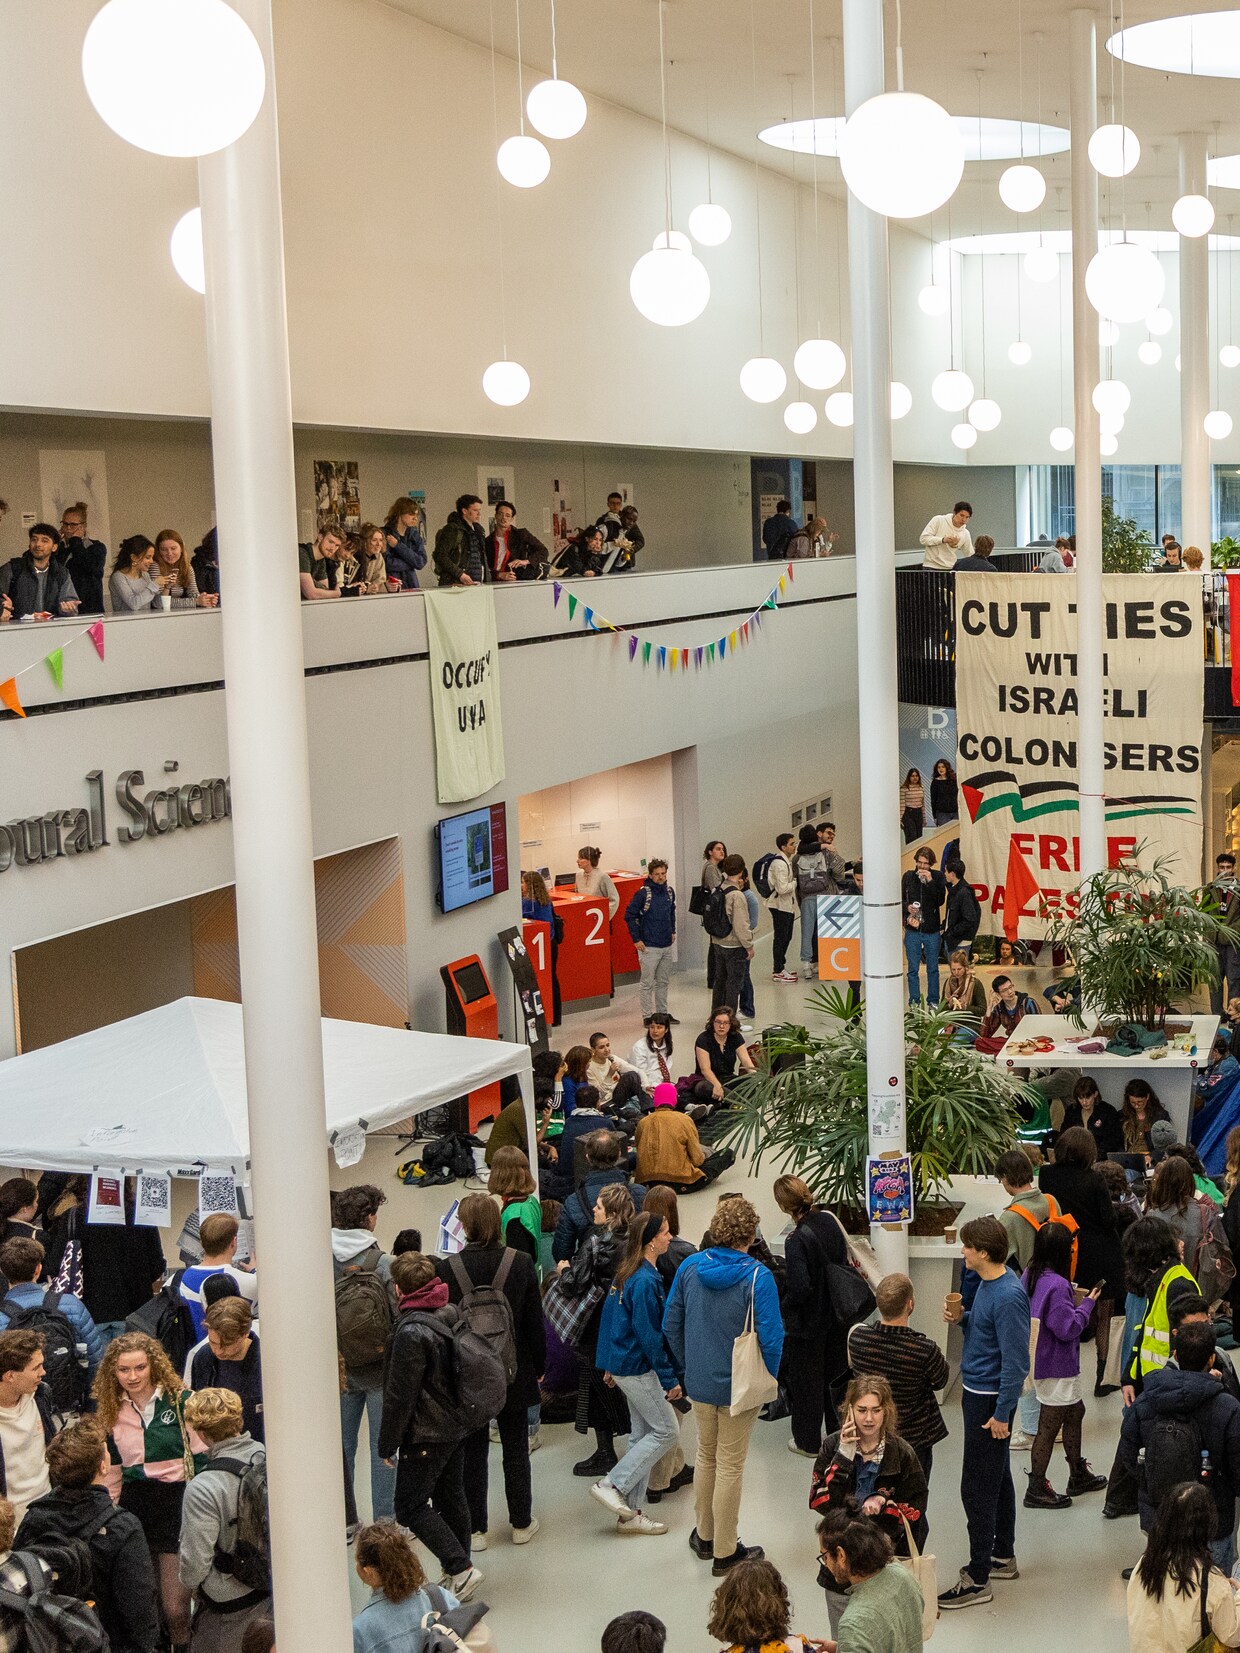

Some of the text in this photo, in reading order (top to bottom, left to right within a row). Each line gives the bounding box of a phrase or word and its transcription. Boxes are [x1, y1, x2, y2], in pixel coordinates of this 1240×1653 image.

[961, 599, 1193, 640] CUT IES
[1025, 652, 1109, 677] WIT
[998, 684, 1148, 718] ISRALI
[959, 732, 1200, 774] COLONSERS
[115, 760, 232, 842] Scien
[1010, 832, 1139, 872] FRE
[585, 907, 605, 946] 2
[532, 931, 546, 971] 1
[830, 947, 849, 972] C
